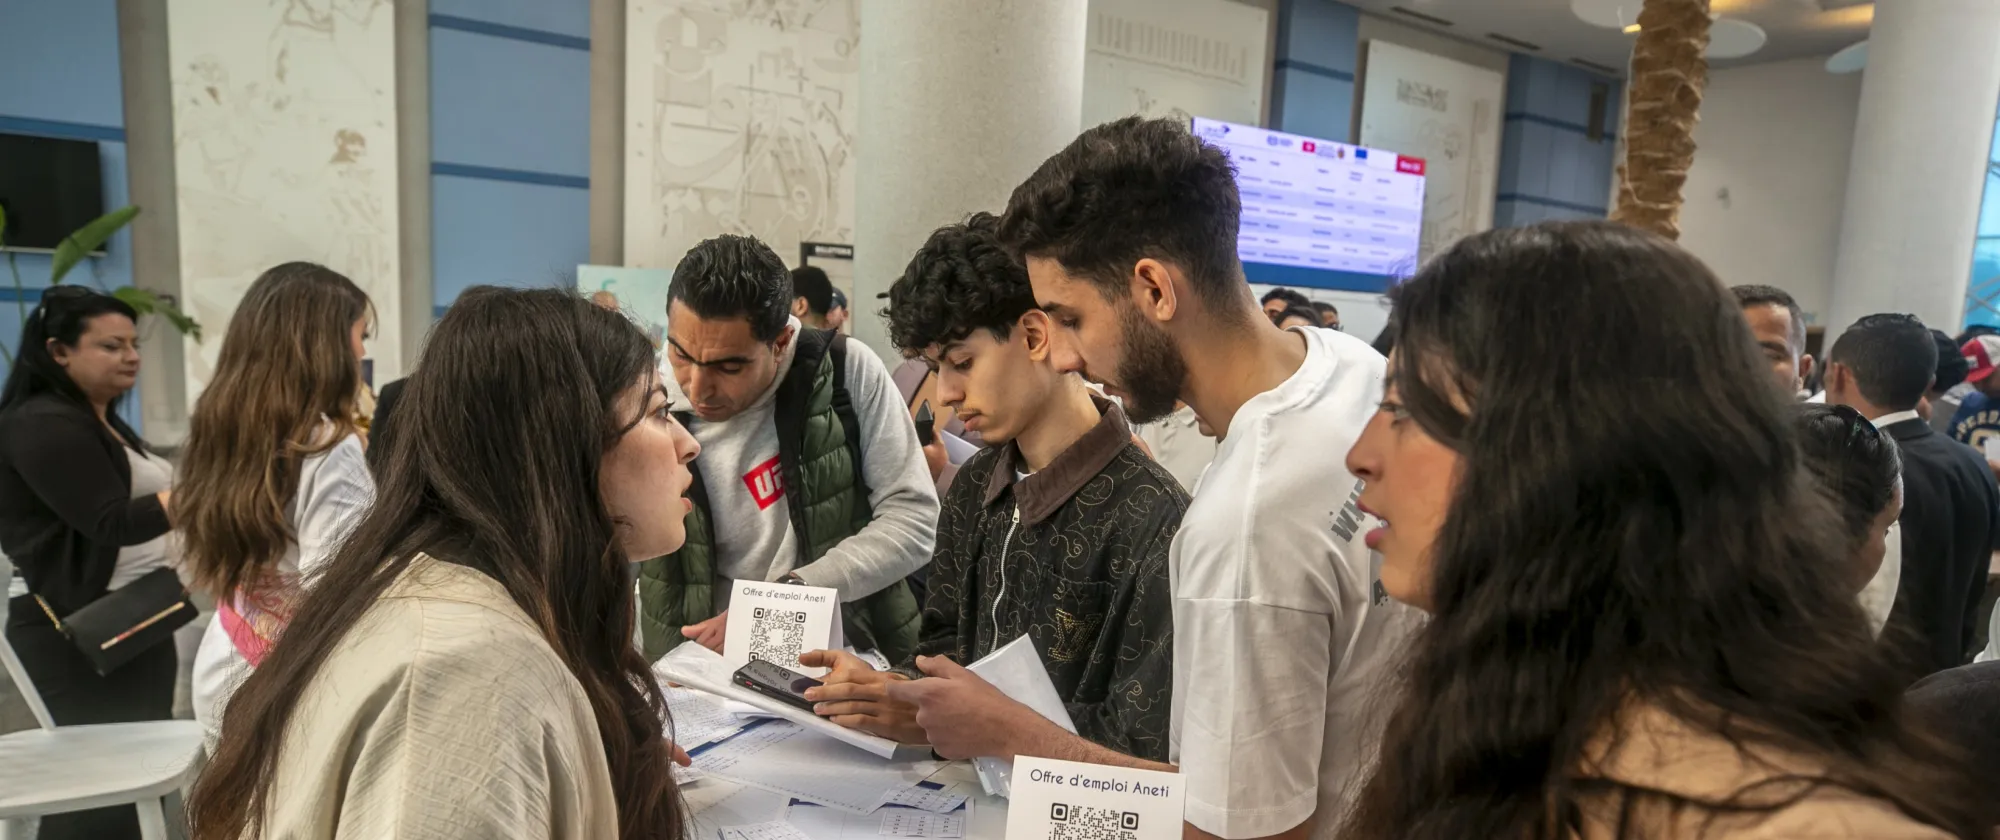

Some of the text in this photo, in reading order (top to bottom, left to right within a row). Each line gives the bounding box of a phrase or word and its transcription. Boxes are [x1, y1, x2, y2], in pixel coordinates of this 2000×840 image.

[742, 587, 826, 603] Offre d'emploi Aneti
[1030, 768, 1170, 798] Offre d'emploi Aneti
